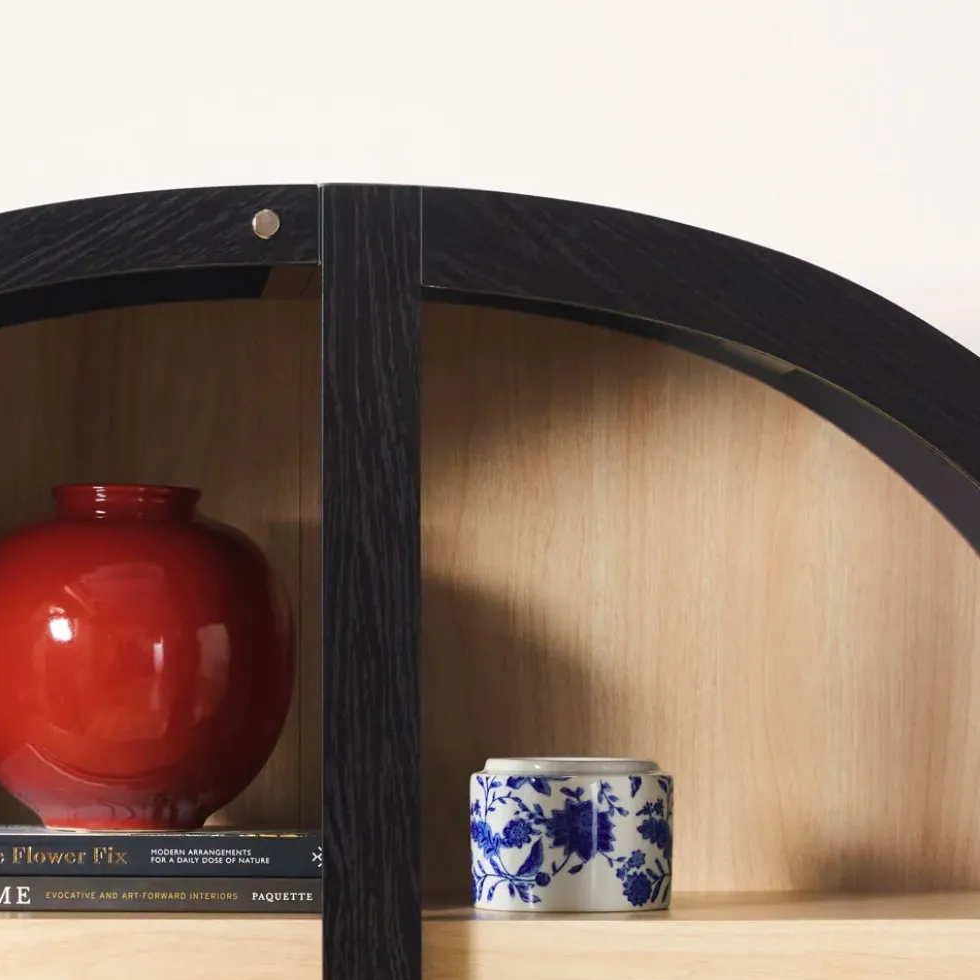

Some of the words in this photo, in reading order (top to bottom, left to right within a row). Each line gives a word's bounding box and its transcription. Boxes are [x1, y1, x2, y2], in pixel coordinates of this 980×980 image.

[11, 845, 87, 865] Flower
[92, 846, 128, 865] Fix
[150, 848, 186, 856] MODERN
[187, 848, 252, 856] ARRANGEMENTS
[150, 856, 167, 864] FOR
[169, 856, 175, 864] A
[45, 891, 96, 899] EVOCATIVE
[189, 892, 239, 900] INTERIORS
[251, 892, 313, 902] PAQUETTE
